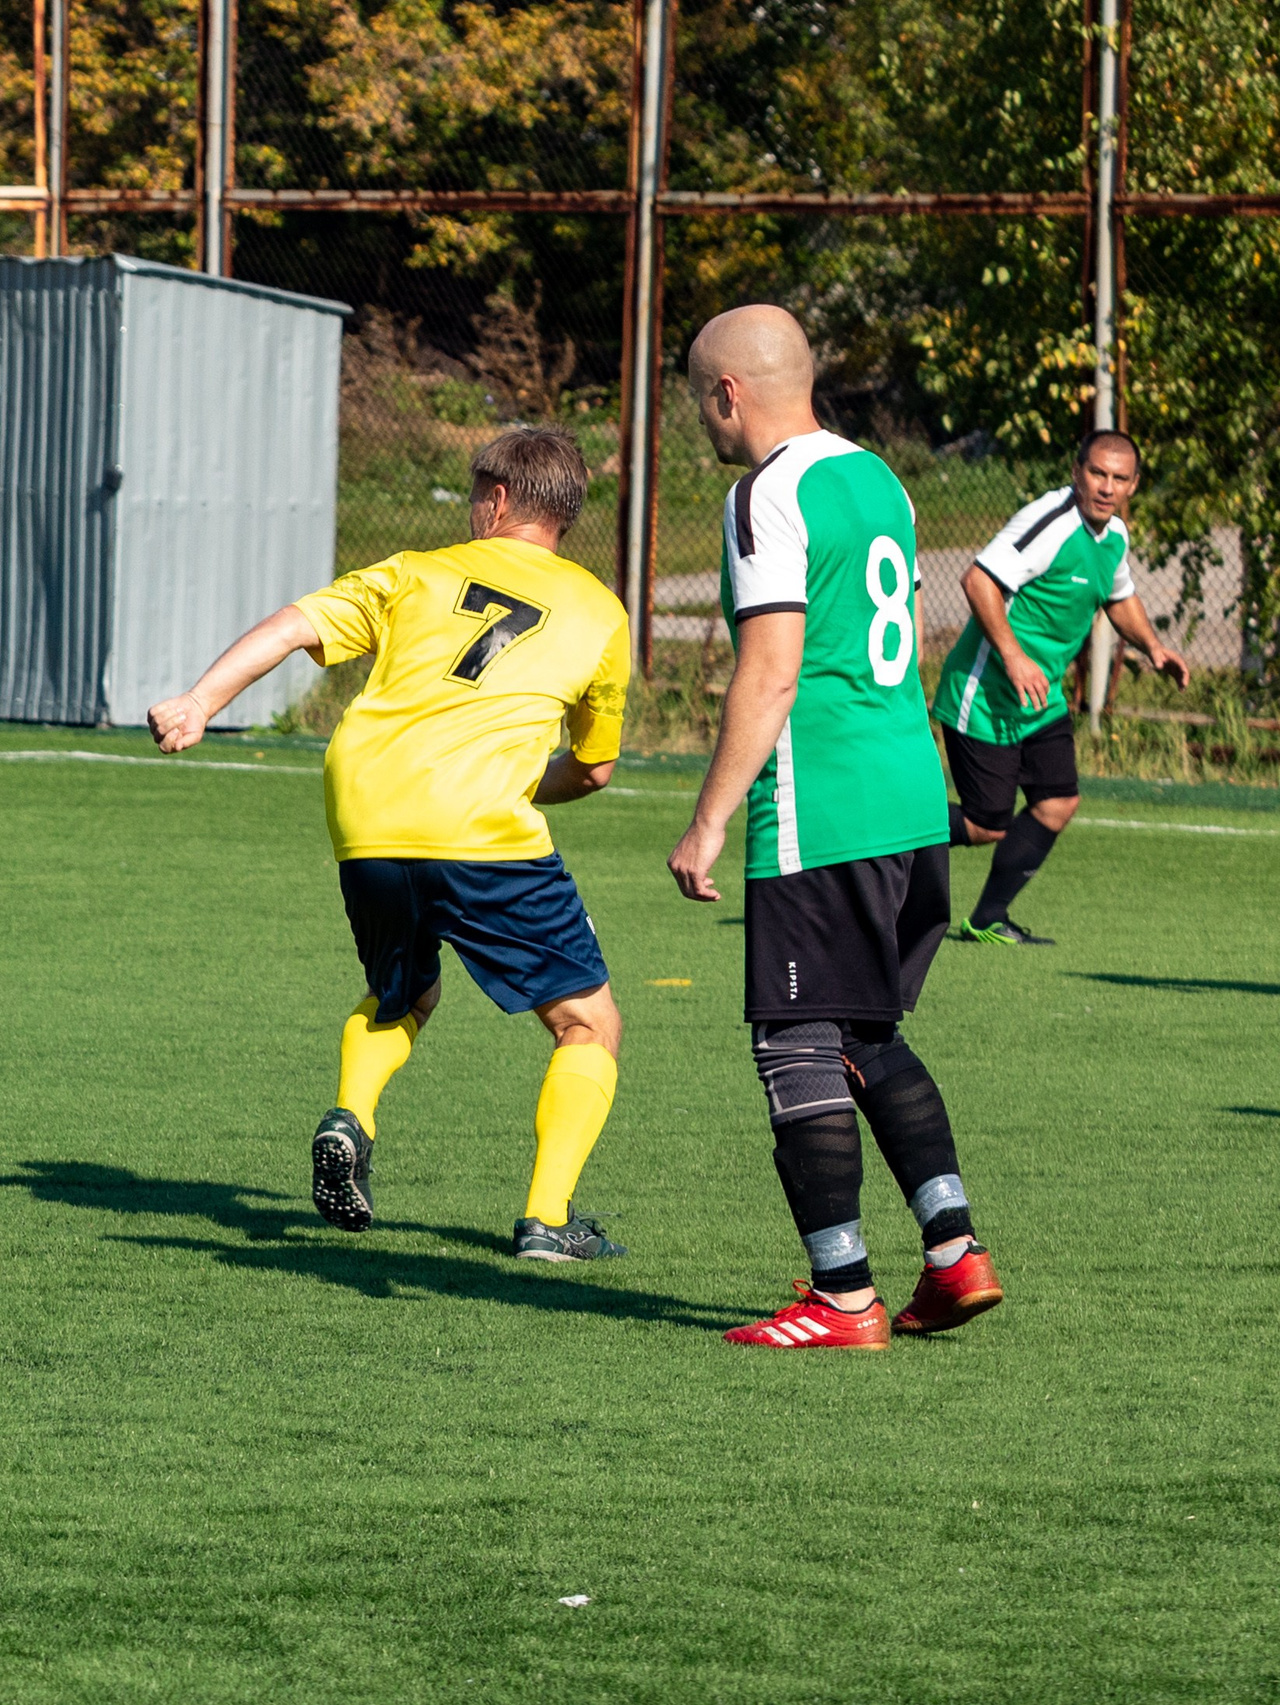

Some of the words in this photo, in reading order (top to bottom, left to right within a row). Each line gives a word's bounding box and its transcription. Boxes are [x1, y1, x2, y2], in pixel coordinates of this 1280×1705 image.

[443, 577, 551, 689] 7
[865, 535, 913, 687] 8
[788, 961, 798, 1000] KIPSTA
